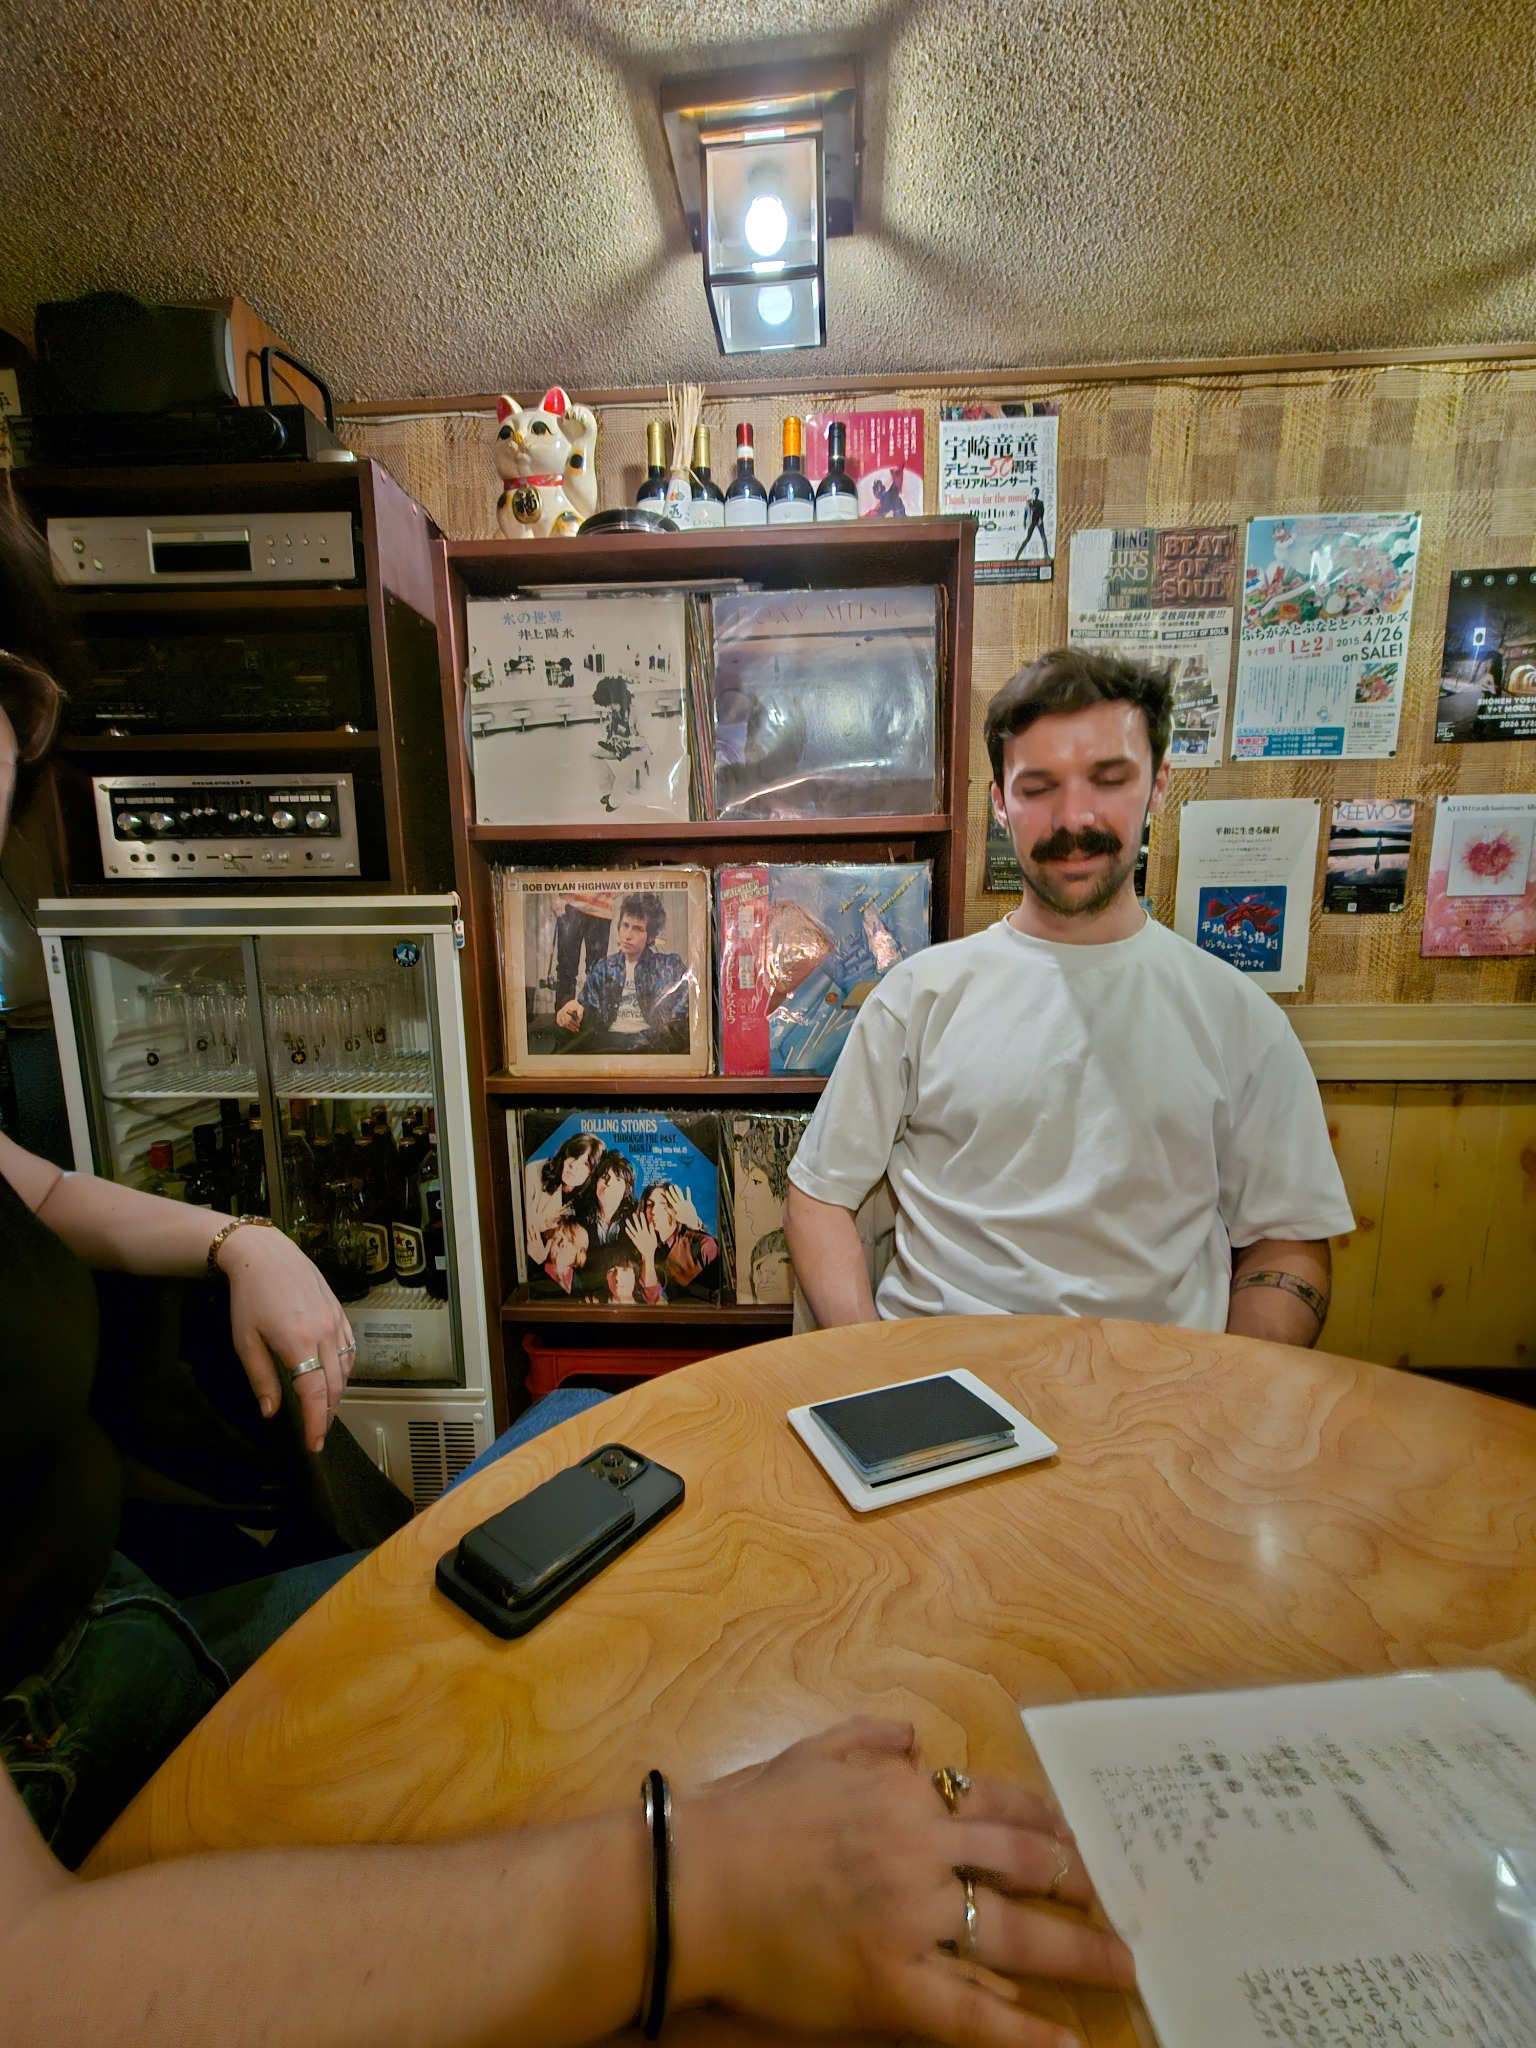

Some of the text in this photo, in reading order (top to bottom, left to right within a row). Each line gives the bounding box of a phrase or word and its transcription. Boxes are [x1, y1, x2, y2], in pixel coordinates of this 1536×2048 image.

[944, 432, 1039, 460] 宇崎竜童
[944, 456, 1038, 478] デビュー50周年
[944, 476, 1037, 489] メモリアルコンサート
[944, 493, 1029, 507] Thank you for the music
[1165, 535, 1231, 556] BEAT
[1179, 558, 1208, 577] OF
[1162, 578, 1227, 599] SOUL
[824, 601, 902, 620] MUSIC
[517, 628, 575, 640] 井上陽水
[1200, 629, 1209, 637] OF
[1209, 627, 1227, 636] SOUL
[1336, 626, 1403, 648] 2015 4/26
[1342, 643, 1403, 663] on SALE!
[1216, 826, 1280, 835] 平和に生きる権利
[522, 881, 688, 892] BOB DYLAN HIGHWAY 61 REVISITED
[580, 1118, 658, 1133] ROLLING STONES
